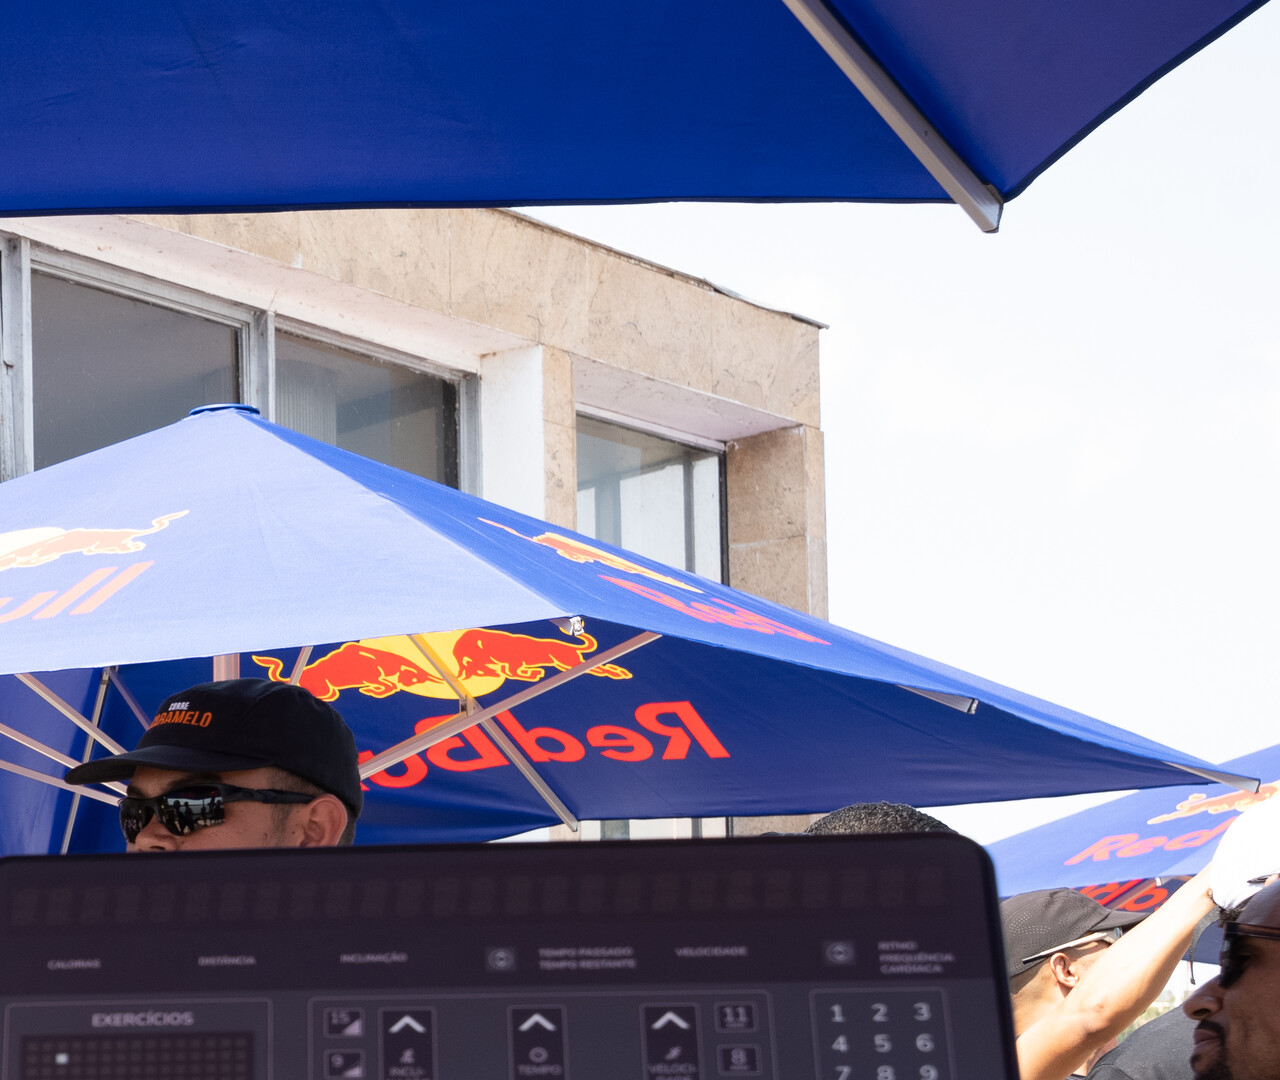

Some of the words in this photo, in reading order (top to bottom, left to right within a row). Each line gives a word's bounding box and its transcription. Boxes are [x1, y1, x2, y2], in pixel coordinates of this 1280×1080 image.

[91, 1010, 194, 1028] EXERCÍCIOS
[830, 1004, 845, 1022] 1
[871, 1003, 889, 1022] 2
[913, 1002, 932, 1021] 3
[831, 1035, 848, 1053] 4
[874, 1034, 892, 1053] 5
[915, 1033, 935, 1052] 6
